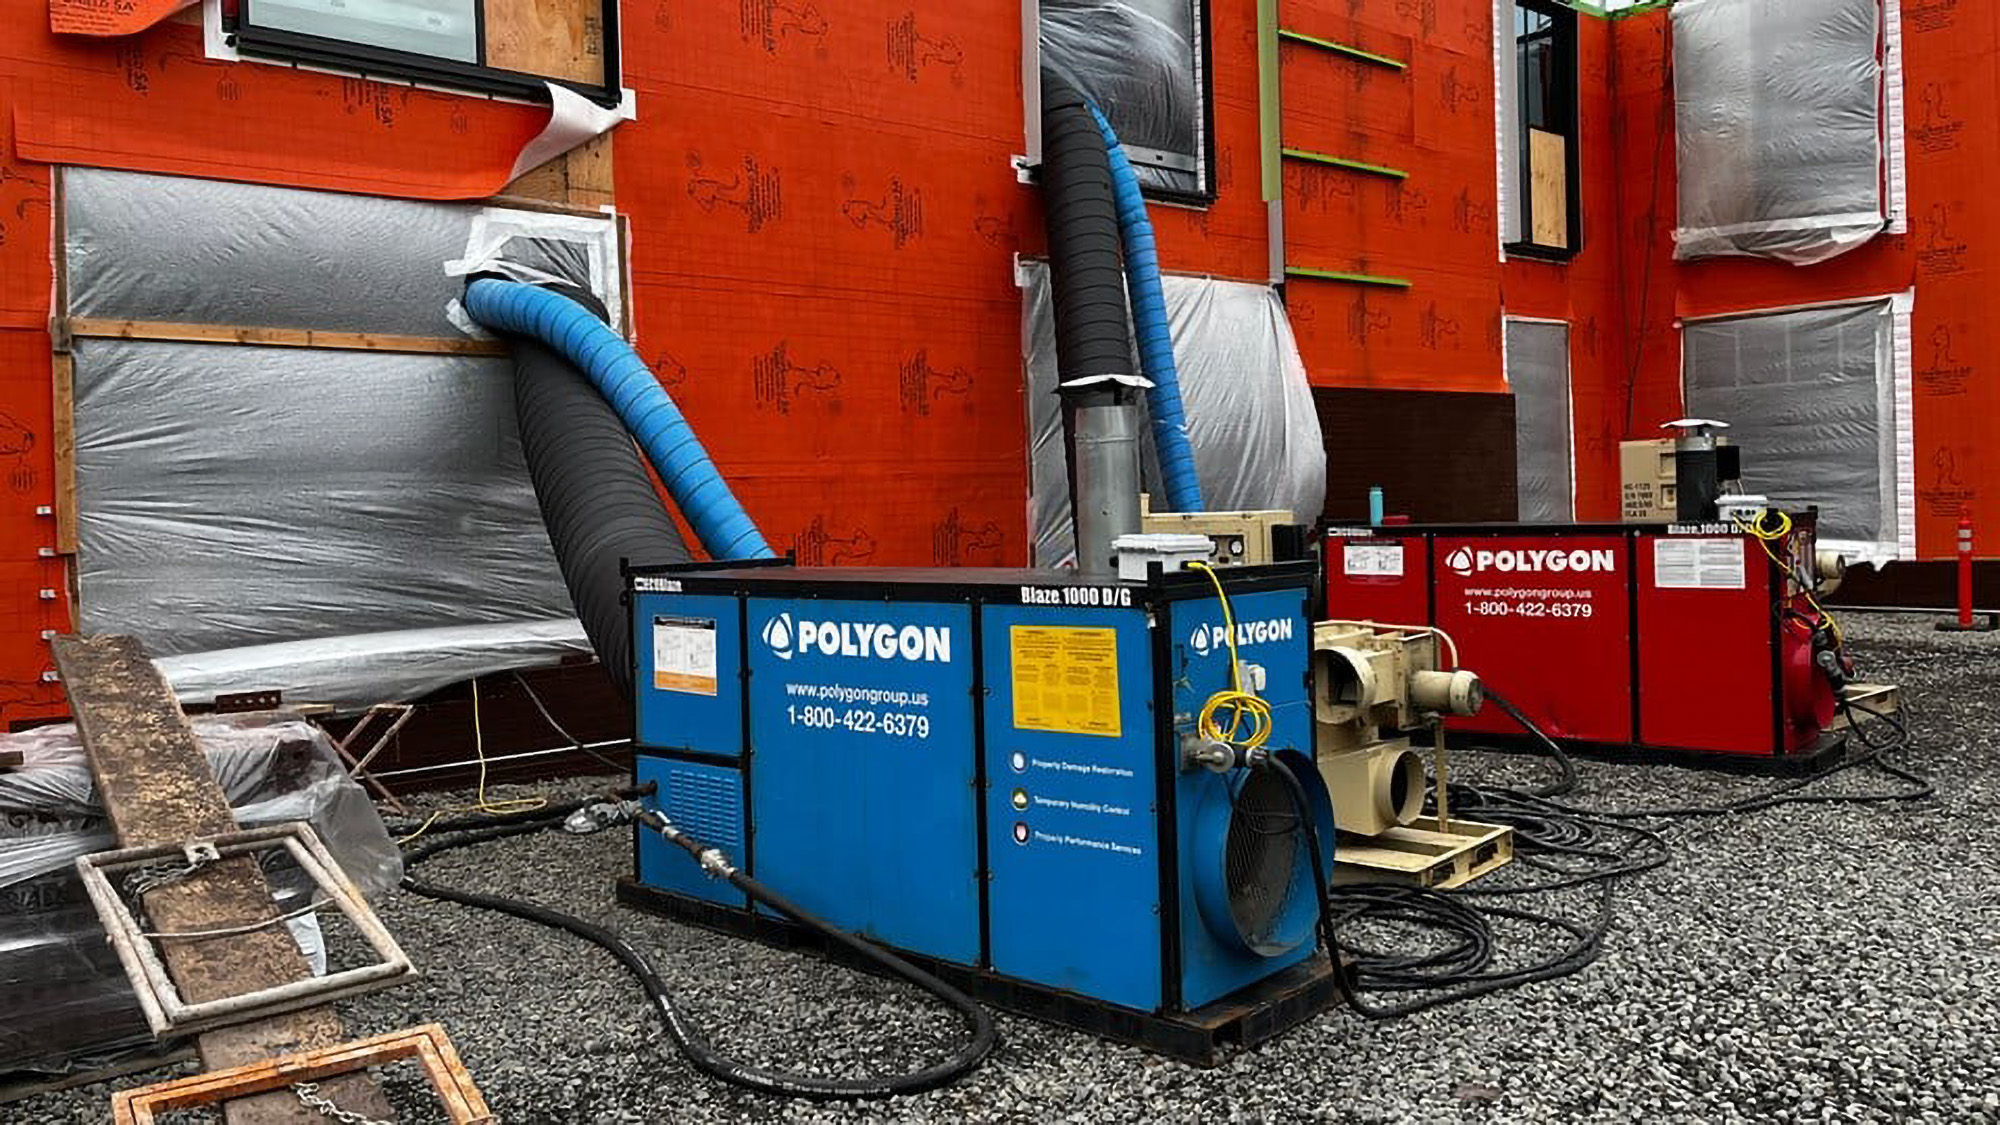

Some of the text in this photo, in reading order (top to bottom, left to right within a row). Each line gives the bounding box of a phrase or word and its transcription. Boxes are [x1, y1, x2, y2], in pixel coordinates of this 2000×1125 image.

[1701, 523, 1728, 534] 1000
[1476, 549, 1616, 572] POLYGON
[1020, 586, 1132, 606] Blaze 1000 D/G
[1464, 587, 1593, 600] www.polygongroup.us
[1465, 601, 1593, 618] 1-800-422-6379
[799, 620, 951, 663] POLYGON
[1212, 617, 1293, 650] POLYGON
[786, 683, 929, 706] www.polygongroup.us
[787, 704, 930, 738] 1-800-422-6379
